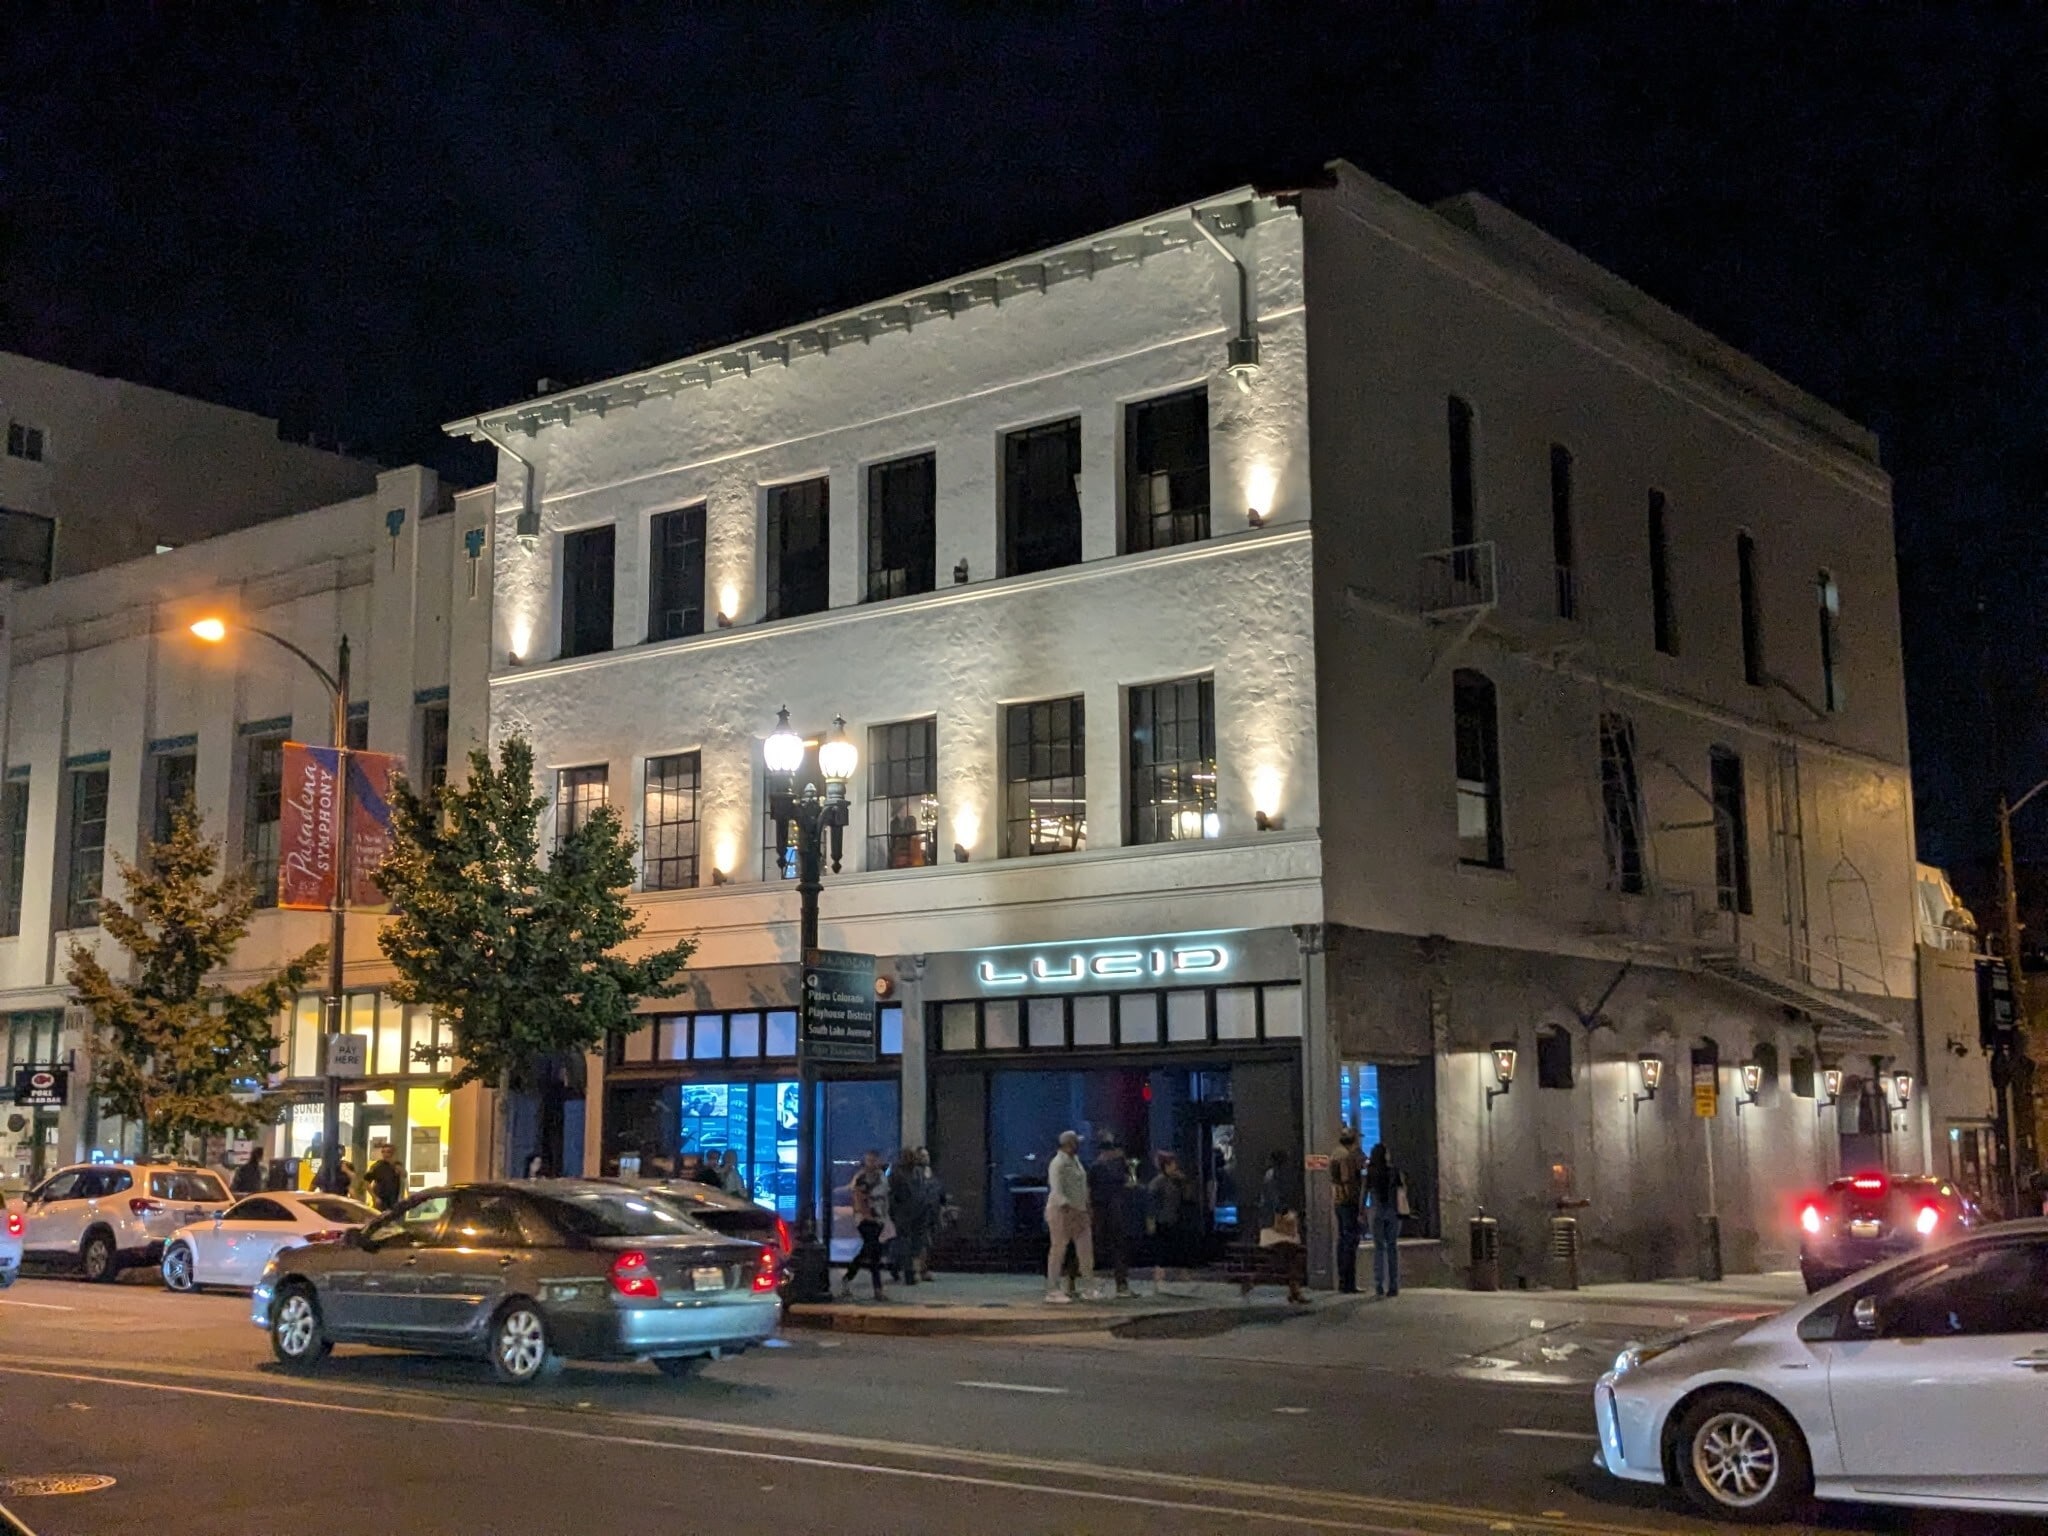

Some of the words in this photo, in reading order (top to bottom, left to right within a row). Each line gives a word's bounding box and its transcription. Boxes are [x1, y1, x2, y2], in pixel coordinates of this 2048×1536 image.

[287, 762, 323, 887] Pasadena
[317, 769, 333, 871] SYMPHONY
[979, 947, 1227, 984] LUCID
[808, 990, 831, 1001] Paseo
[832, 991, 865, 1003] Colorado
[808, 1007, 846, 1020] Playhouse
[846, 1009, 872, 1021] District
[808, 1023, 828, 1036] South
[829, 1025, 846, 1037] Lake
[846, 1026, 872, 1038] Avenue
[339, 1046, 356, 1055] PAY
[335, 1055, 359, 1065] HERE
